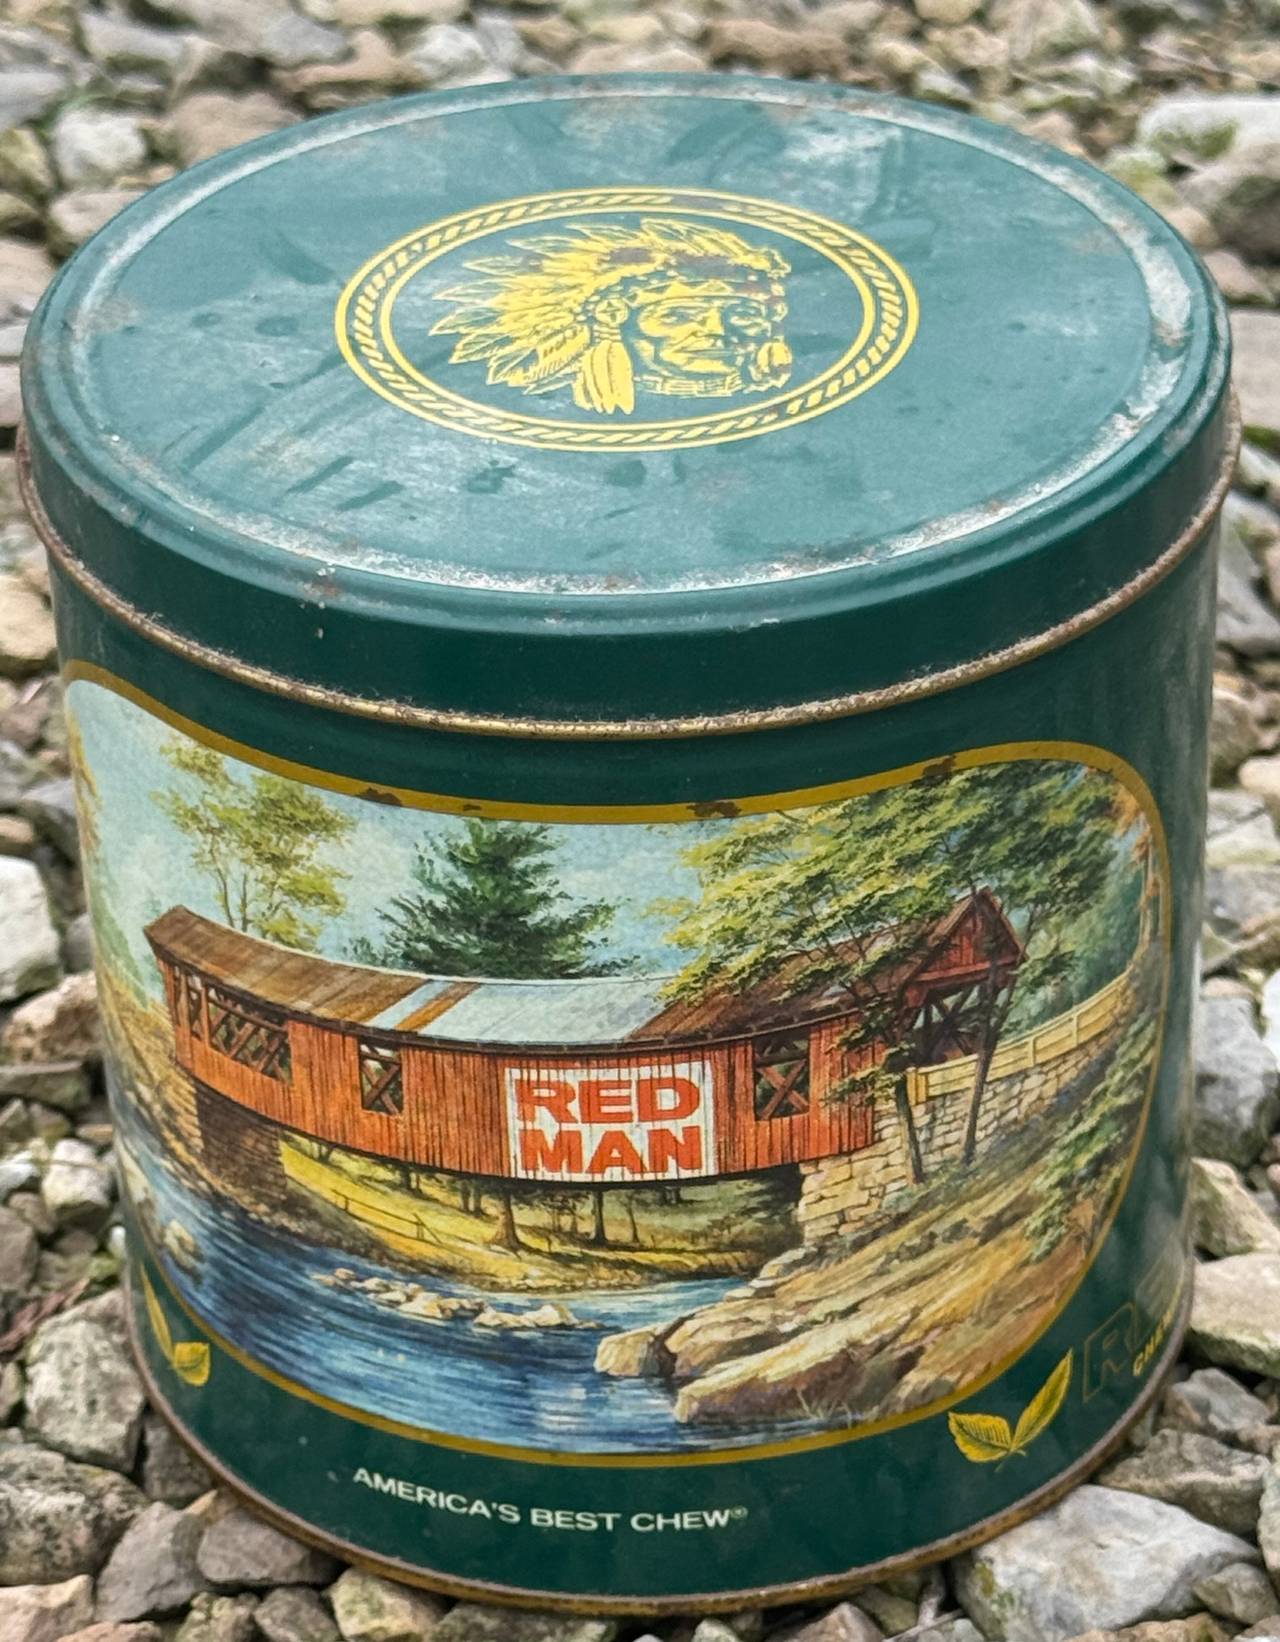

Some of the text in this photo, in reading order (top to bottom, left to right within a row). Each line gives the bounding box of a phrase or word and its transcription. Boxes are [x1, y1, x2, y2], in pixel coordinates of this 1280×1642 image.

[515, 1077, 701, 1124] RED
[519, 1126, 702, 1174] MAN
[353, 1467, 521, 1524] AMERICA'S
[530, 1498, 622, 1531] BEST
